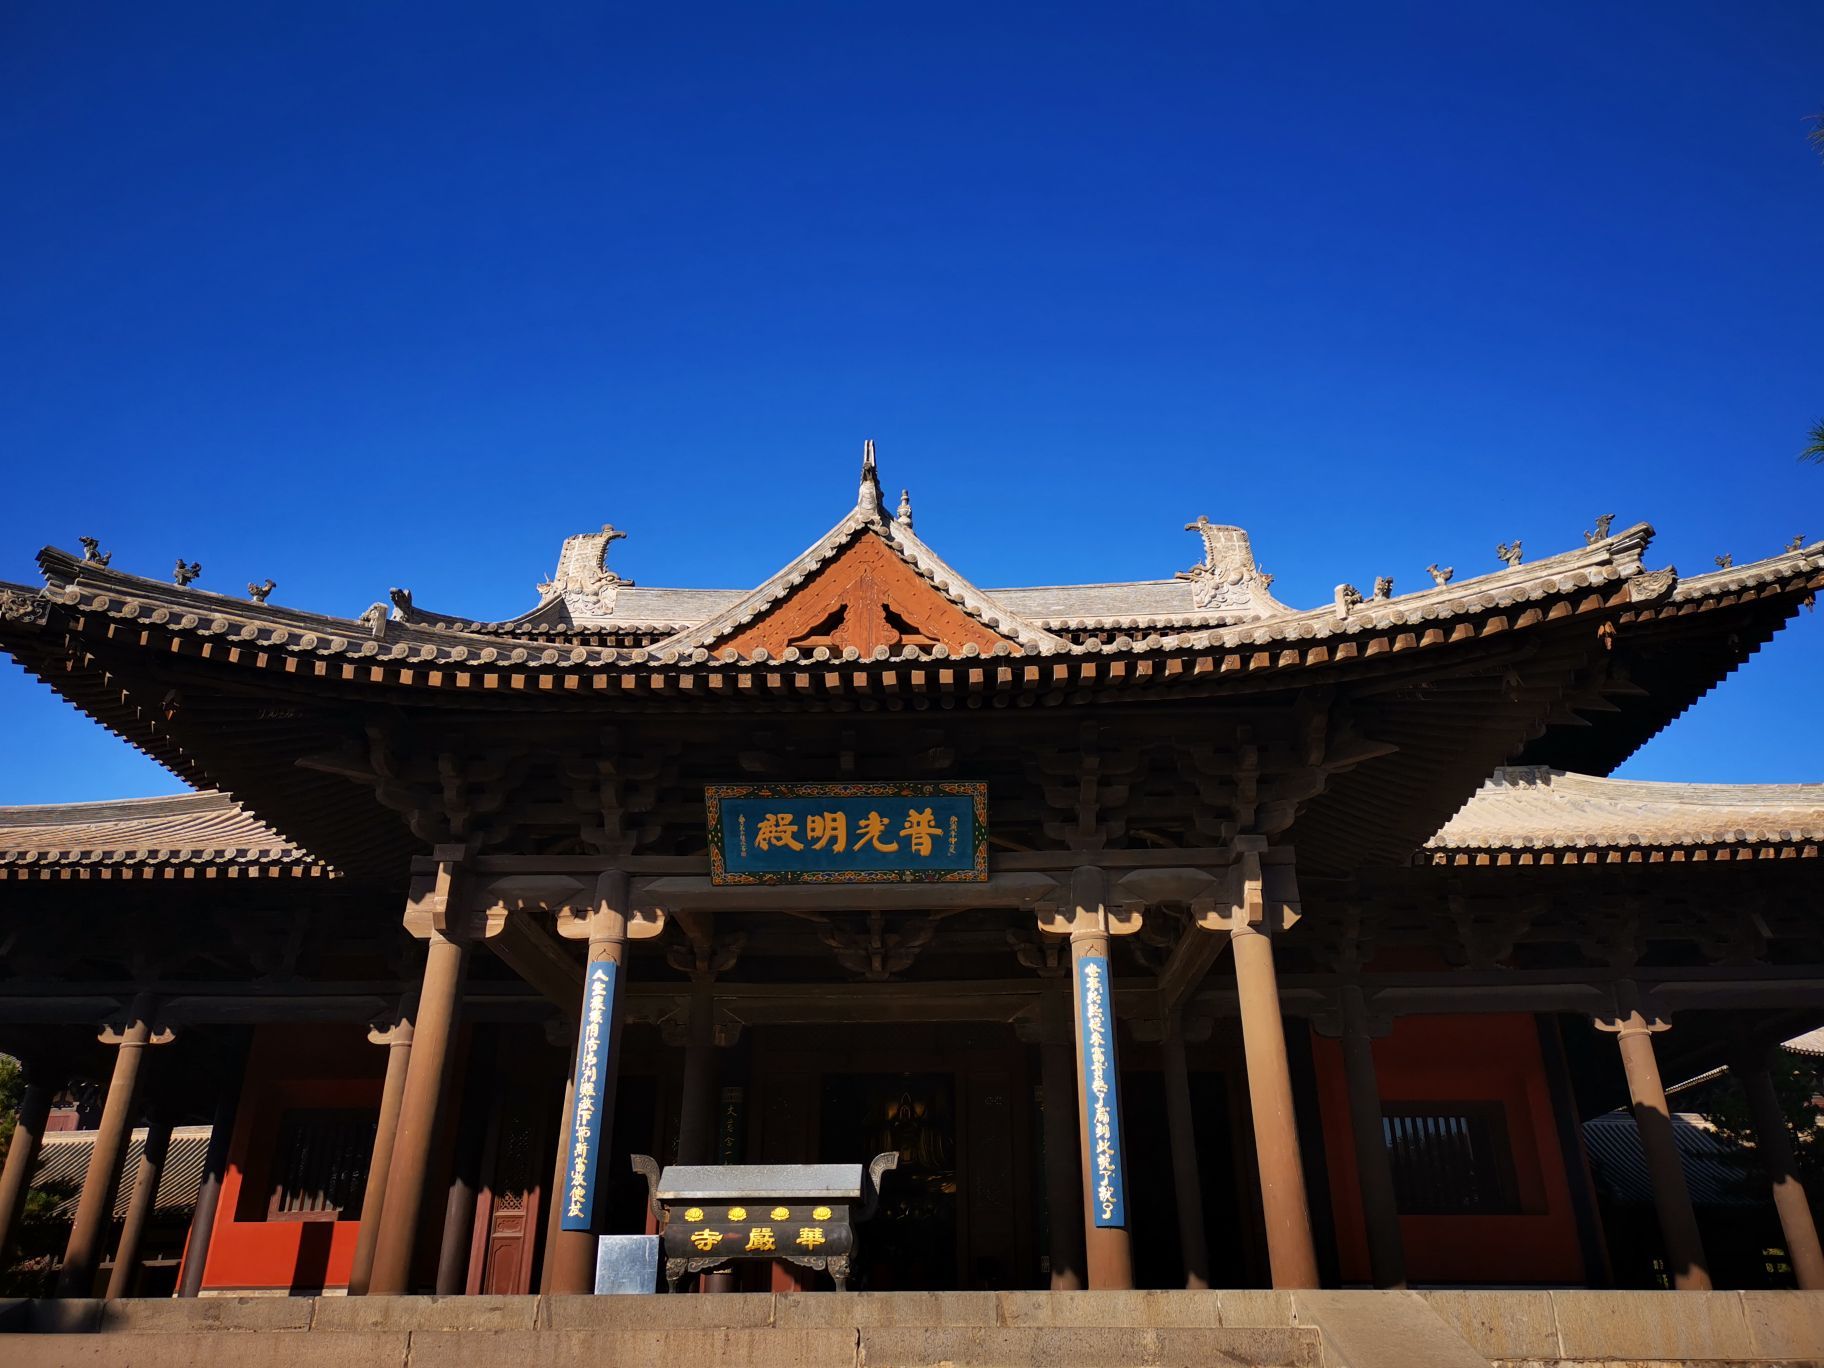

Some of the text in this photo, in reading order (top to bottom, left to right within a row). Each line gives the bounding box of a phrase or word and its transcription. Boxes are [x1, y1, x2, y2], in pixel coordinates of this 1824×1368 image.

[754, 807, 944, 857] 普光明殿
[690, 1227, 826, 1252] 華嚴寺
